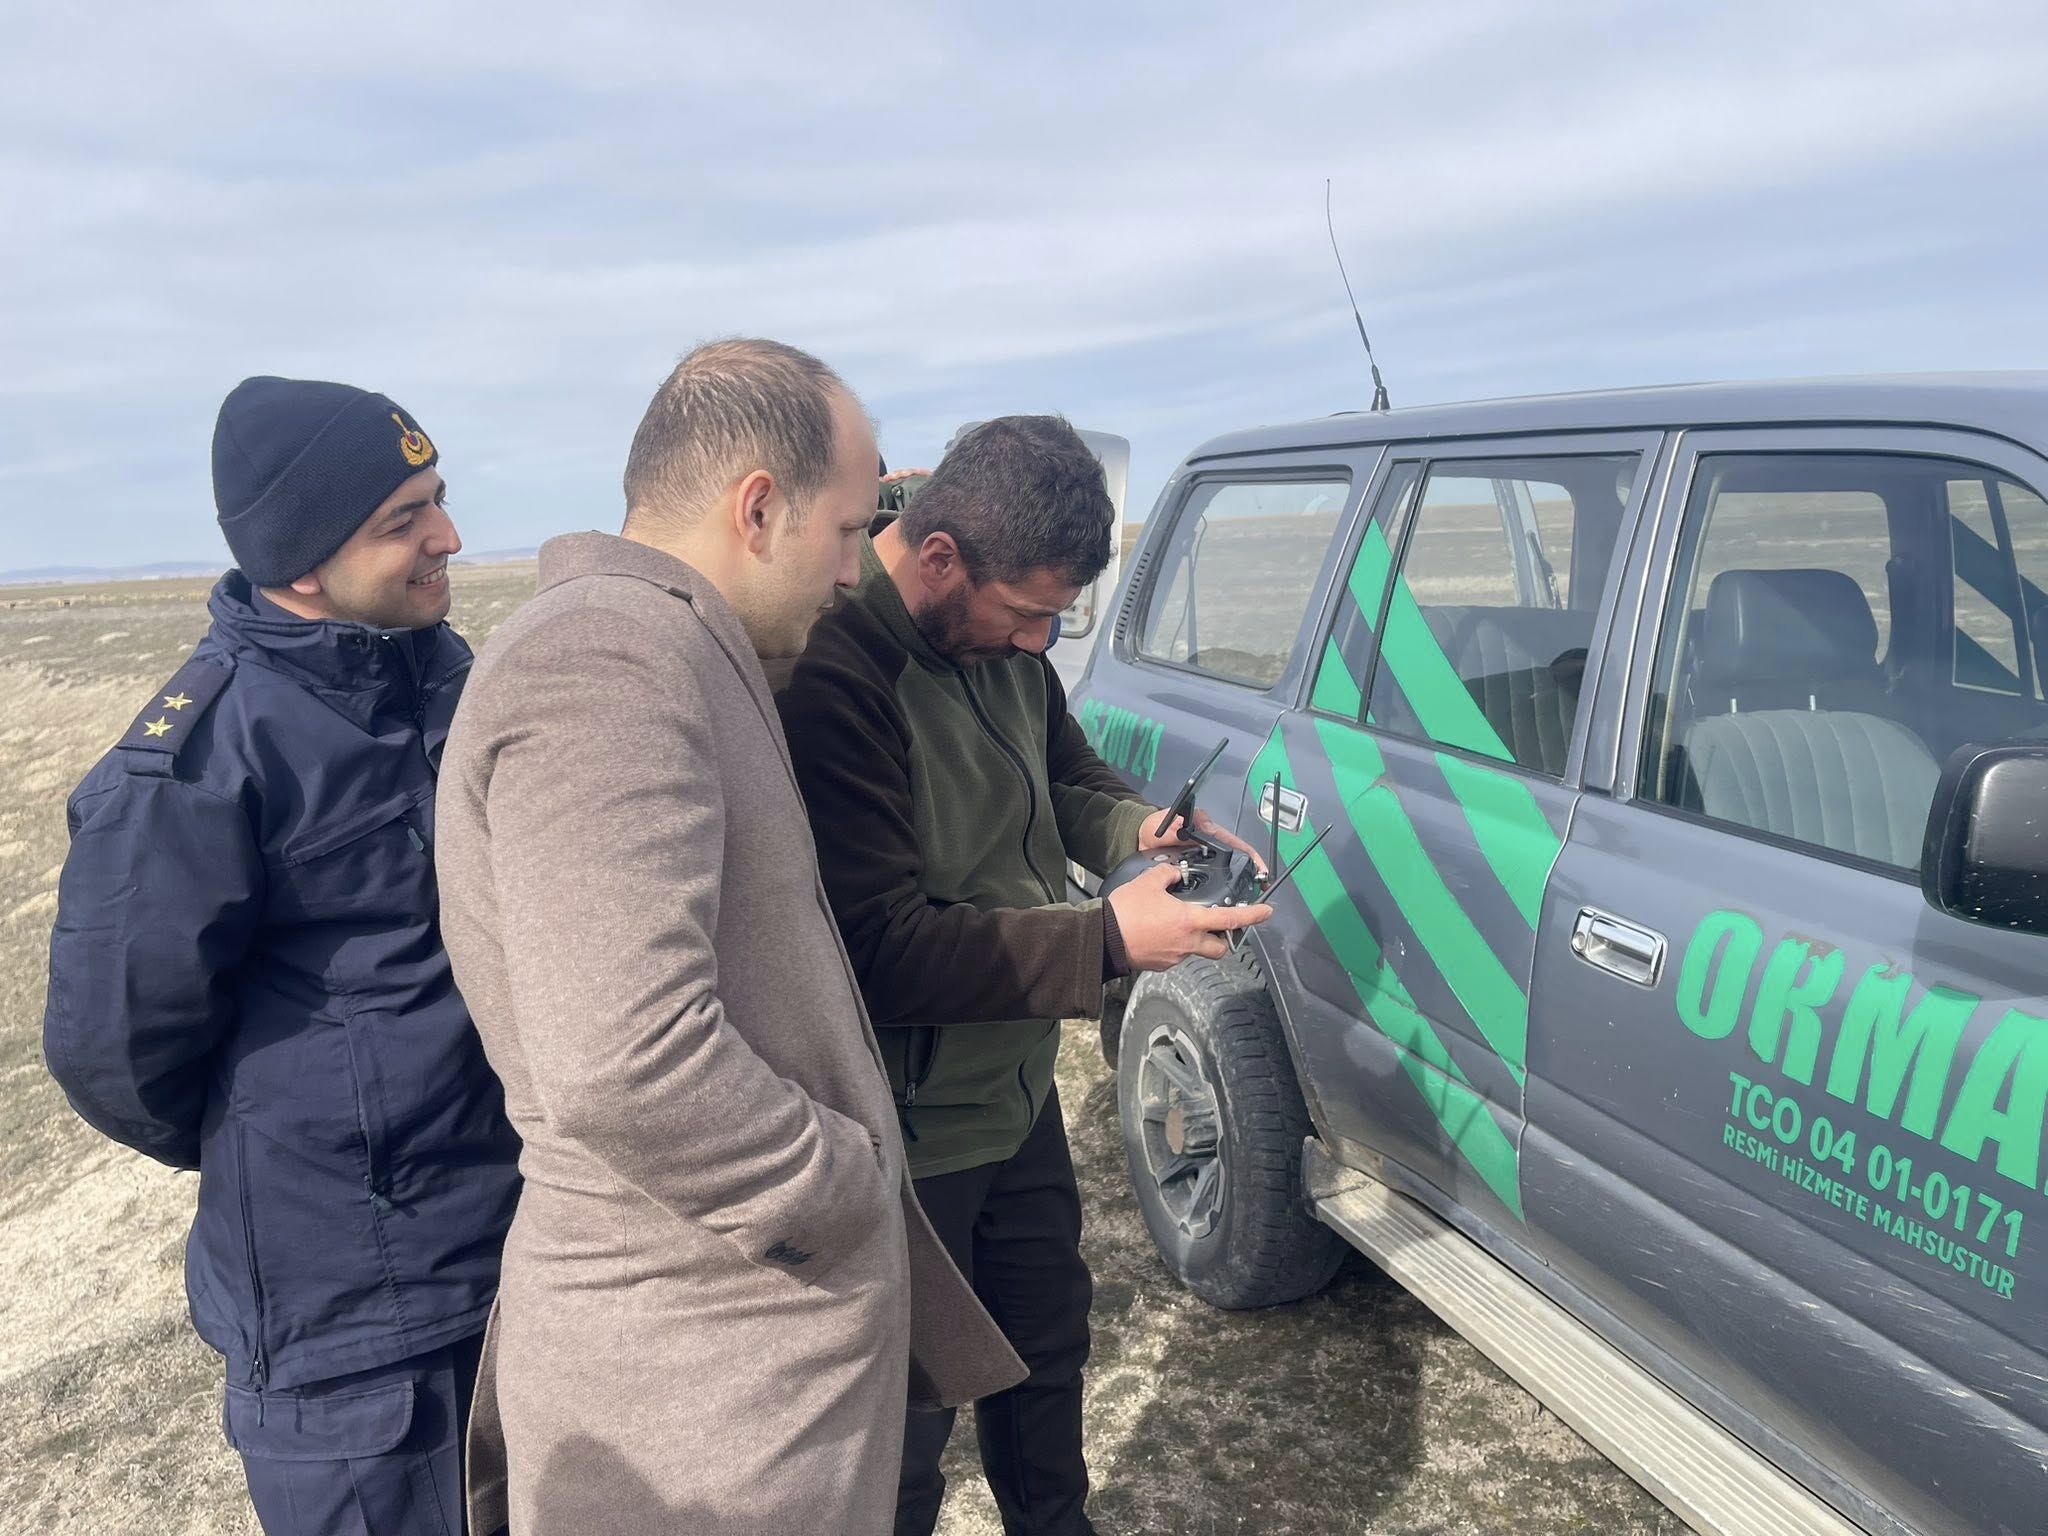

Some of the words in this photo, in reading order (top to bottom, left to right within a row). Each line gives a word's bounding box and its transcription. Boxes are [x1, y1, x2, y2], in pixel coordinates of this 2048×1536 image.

[1674, 908, 2048, 1197] ORMA
[1727, 1071, 1803, 1145] TCO
[1808, 1115, 1857, 1175] 04
[1867, 1143, 2024, 1258] 01-0171
[1781, 1156, 1867, 1222] HİZMETE
[1872, 1203, 2016, 1299] MAHSUSTUR
